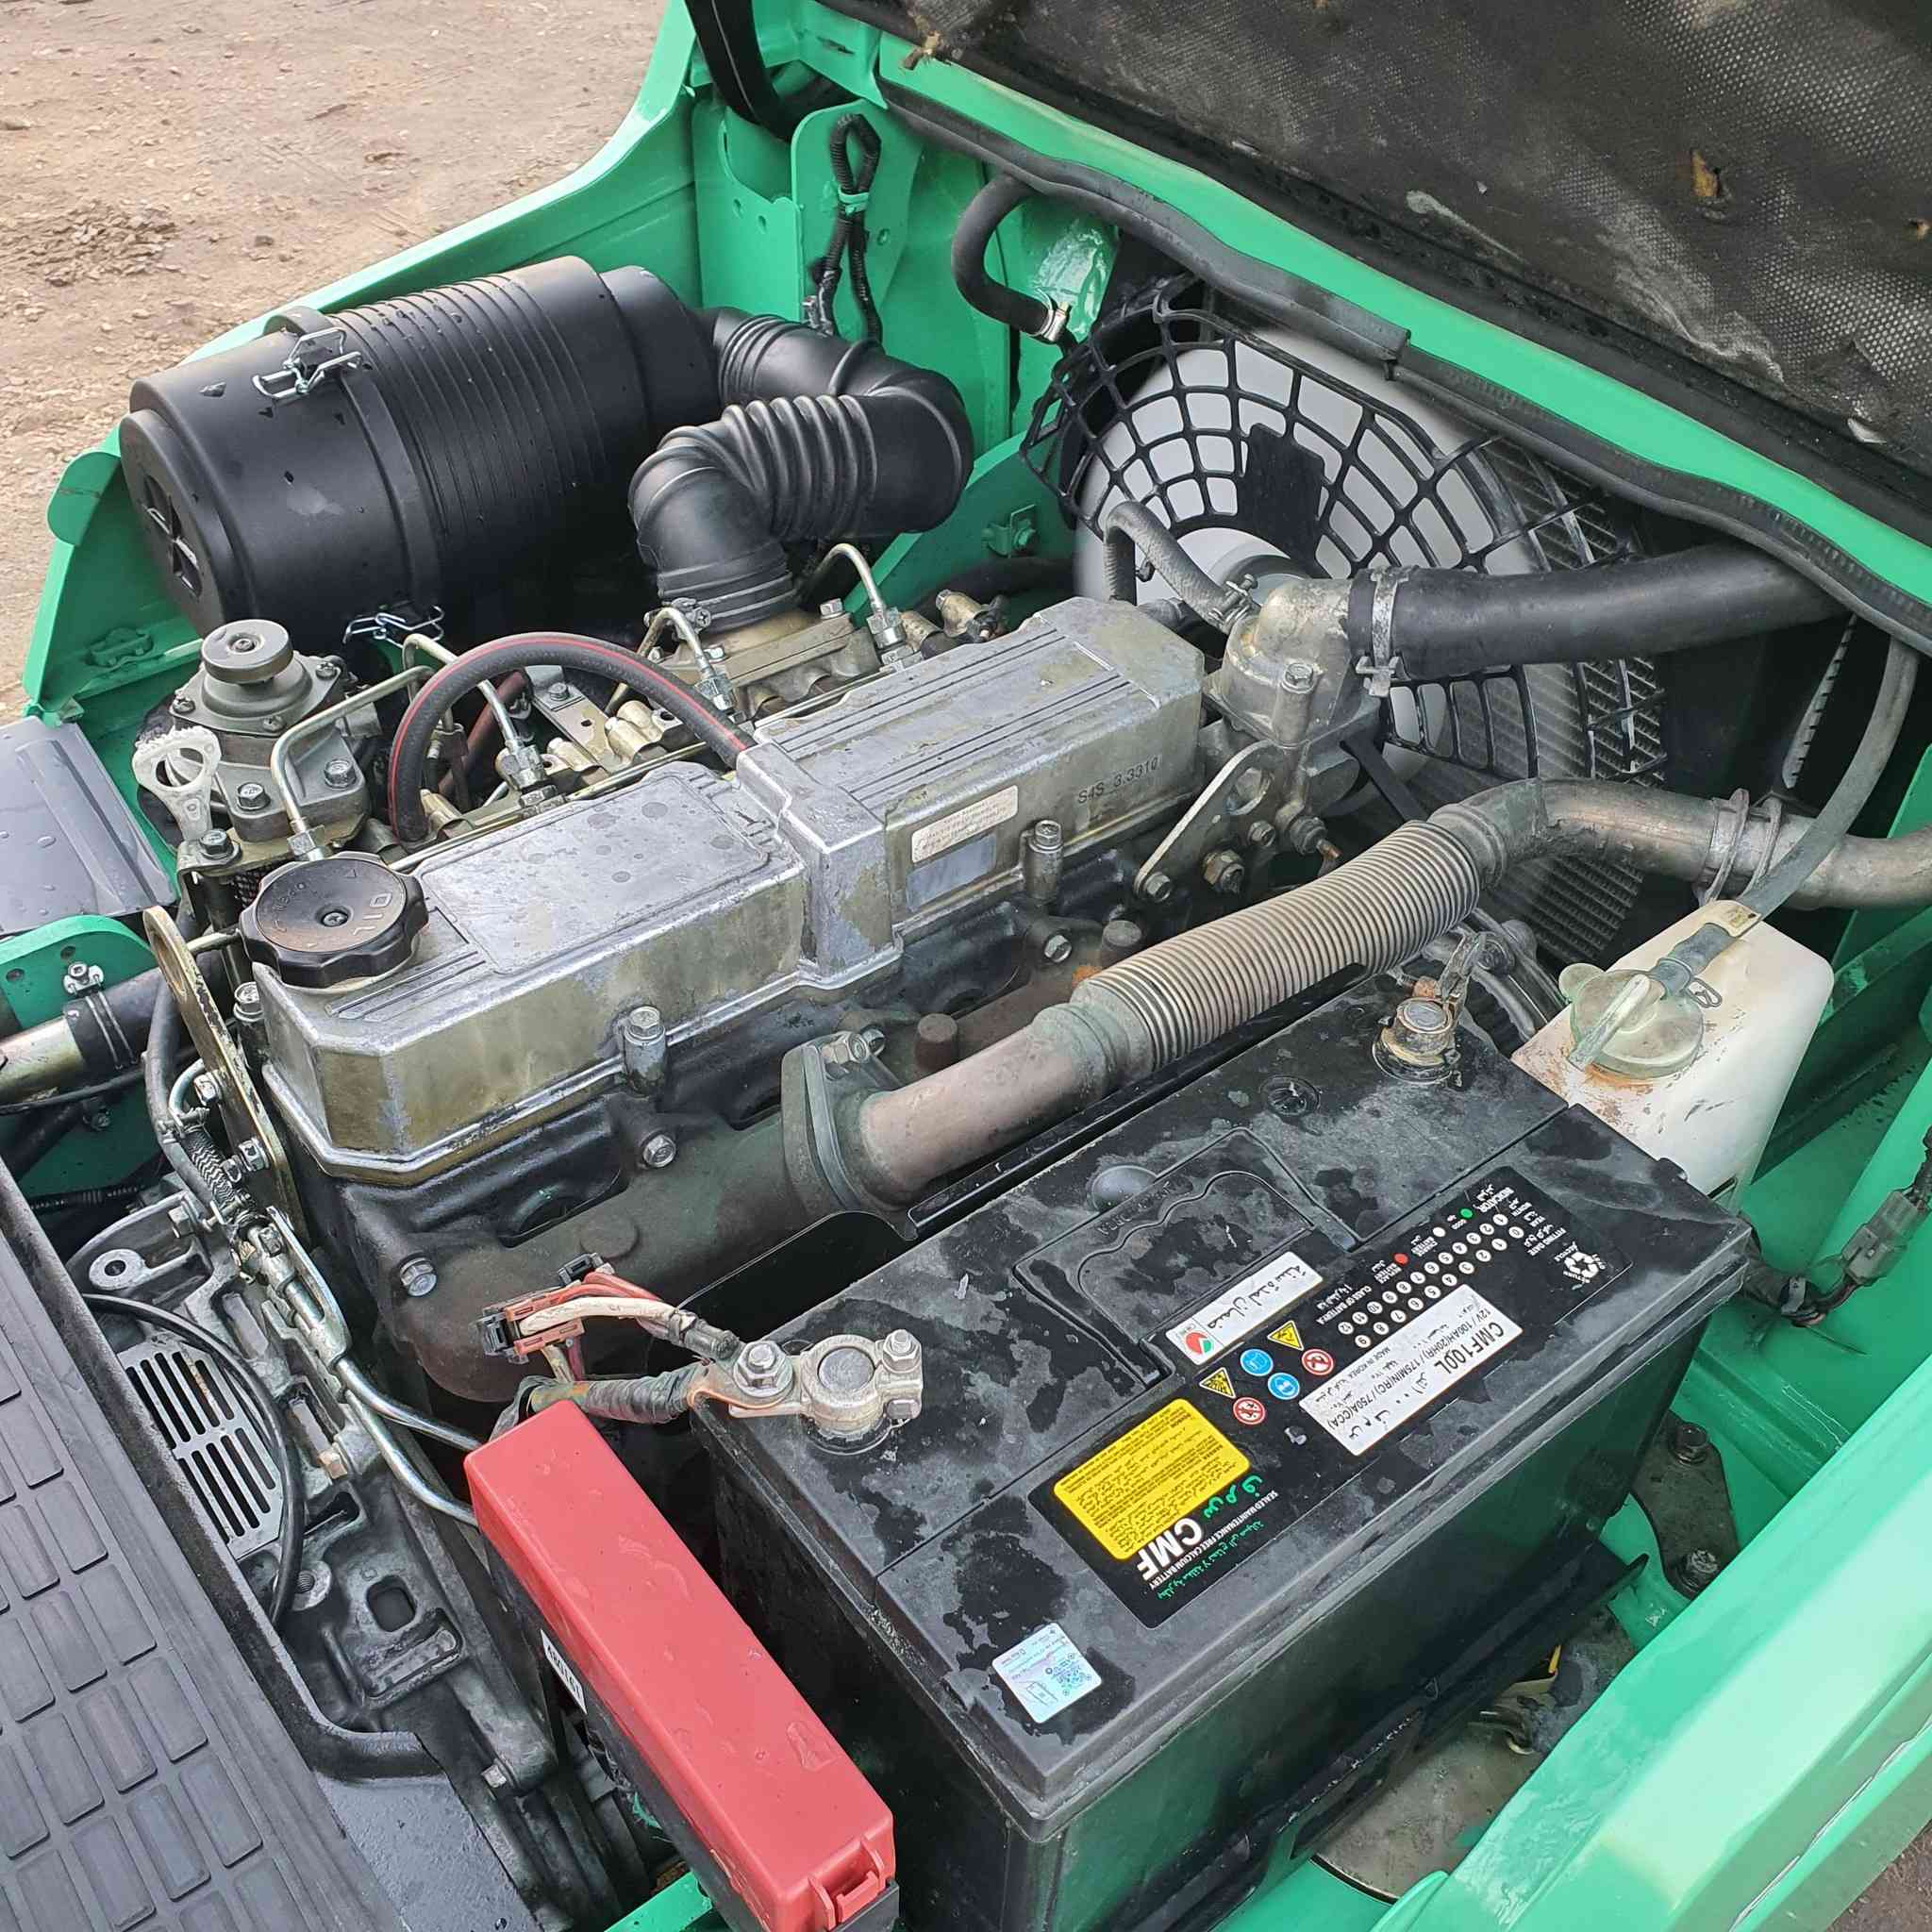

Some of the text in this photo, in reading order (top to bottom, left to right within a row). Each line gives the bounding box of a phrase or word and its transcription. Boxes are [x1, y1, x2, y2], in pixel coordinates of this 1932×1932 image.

[352, 892, 392, 936] OIL
[1475, 1186, 1514, 1212] INDICATOR
[1510, 1201, 1532, 1217] MONTH
[1528, 1214, 1545, 1227] YEAR
[1526, 1226, 1566, 1256] FITTING DATE
[1206, 1295, 1248, 1329] ضمان
[1246, 1280, 1279, 1307] لمدة
[1274, 1264, 1307, 1282] سنة
[1350, 1284, 1372, 1301] CLASS
[1474, 1307, 1491, 1323] 12V
[1372, 1345, 1391, 1360] MADE
[1421, 1320, 1473, 1359] 100AH(20HR)
[1433, 1321, 1504, 1374] CMF100L
[1346, 1362, 1368, 1379] KOREA
[1373, 1358, 1421, 1395] 175MIN(RC)
[1325, 1393, 1373, 1430] 750A(CCA)
[1137, 1517, 1202, 1579] CMF
[1148, 1489, 1278, 1590] SEALED MAINTENANCE FREE CALCIUM BATTERY
